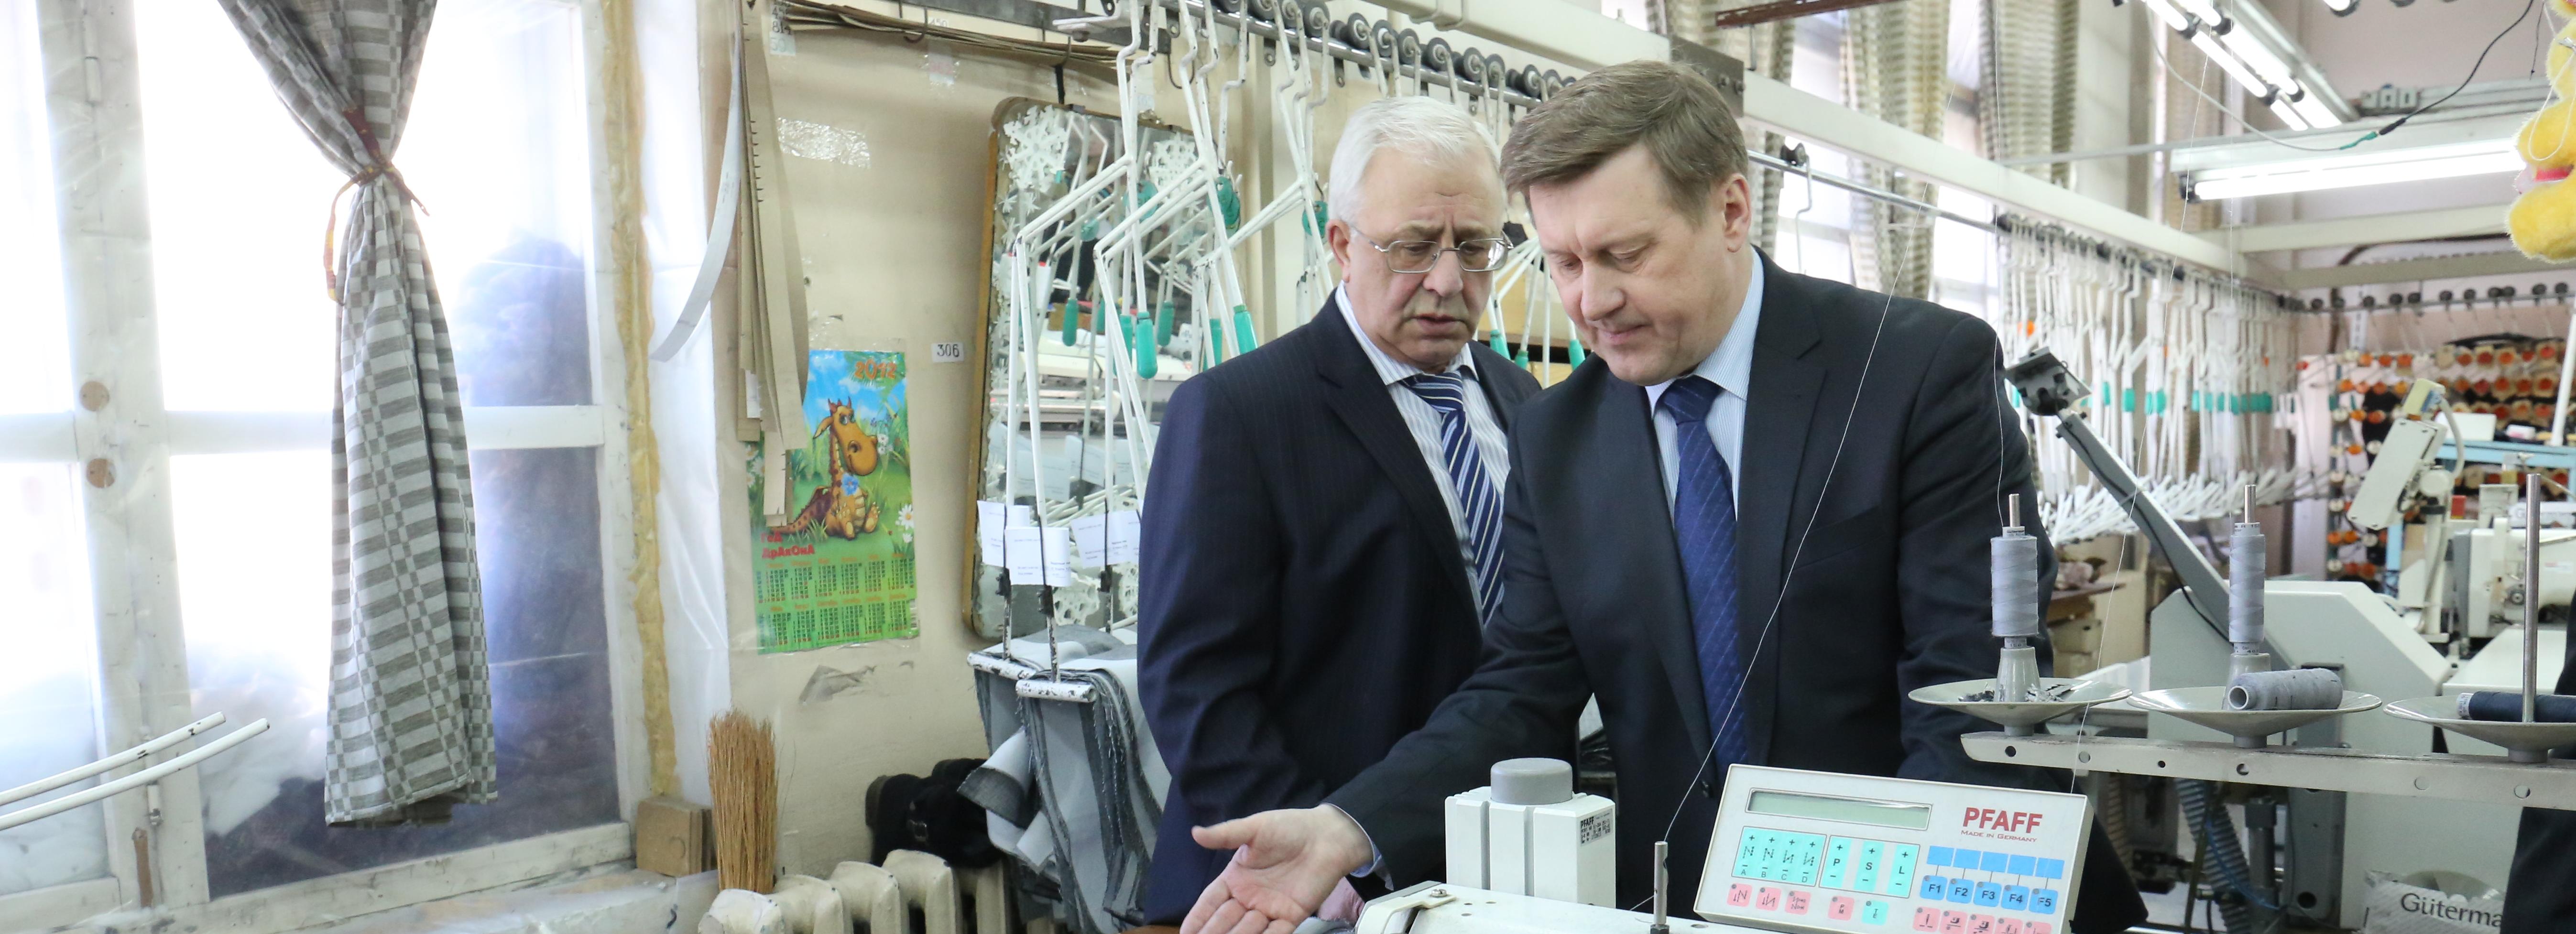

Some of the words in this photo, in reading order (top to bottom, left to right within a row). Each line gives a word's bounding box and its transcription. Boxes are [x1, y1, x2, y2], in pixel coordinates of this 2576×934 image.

[937, 343, 960, 358] 306
[854, 358, 896, 380] 2012
[1580, 816, 1594, 829] PFAFF
[1963, 807, 2043, 834] PFAFF
[1899, 866, 1905, 874] L
[1928, 884, 1941, 893] F1
[1954, 887, 1968, 897] F2
[1982, 890, 1996, 900] F3
[2009, 893, 2023, 903] F4
[2038, 897, 2052, 907] F5
[2401, 893, 2502, 927] Güterma
